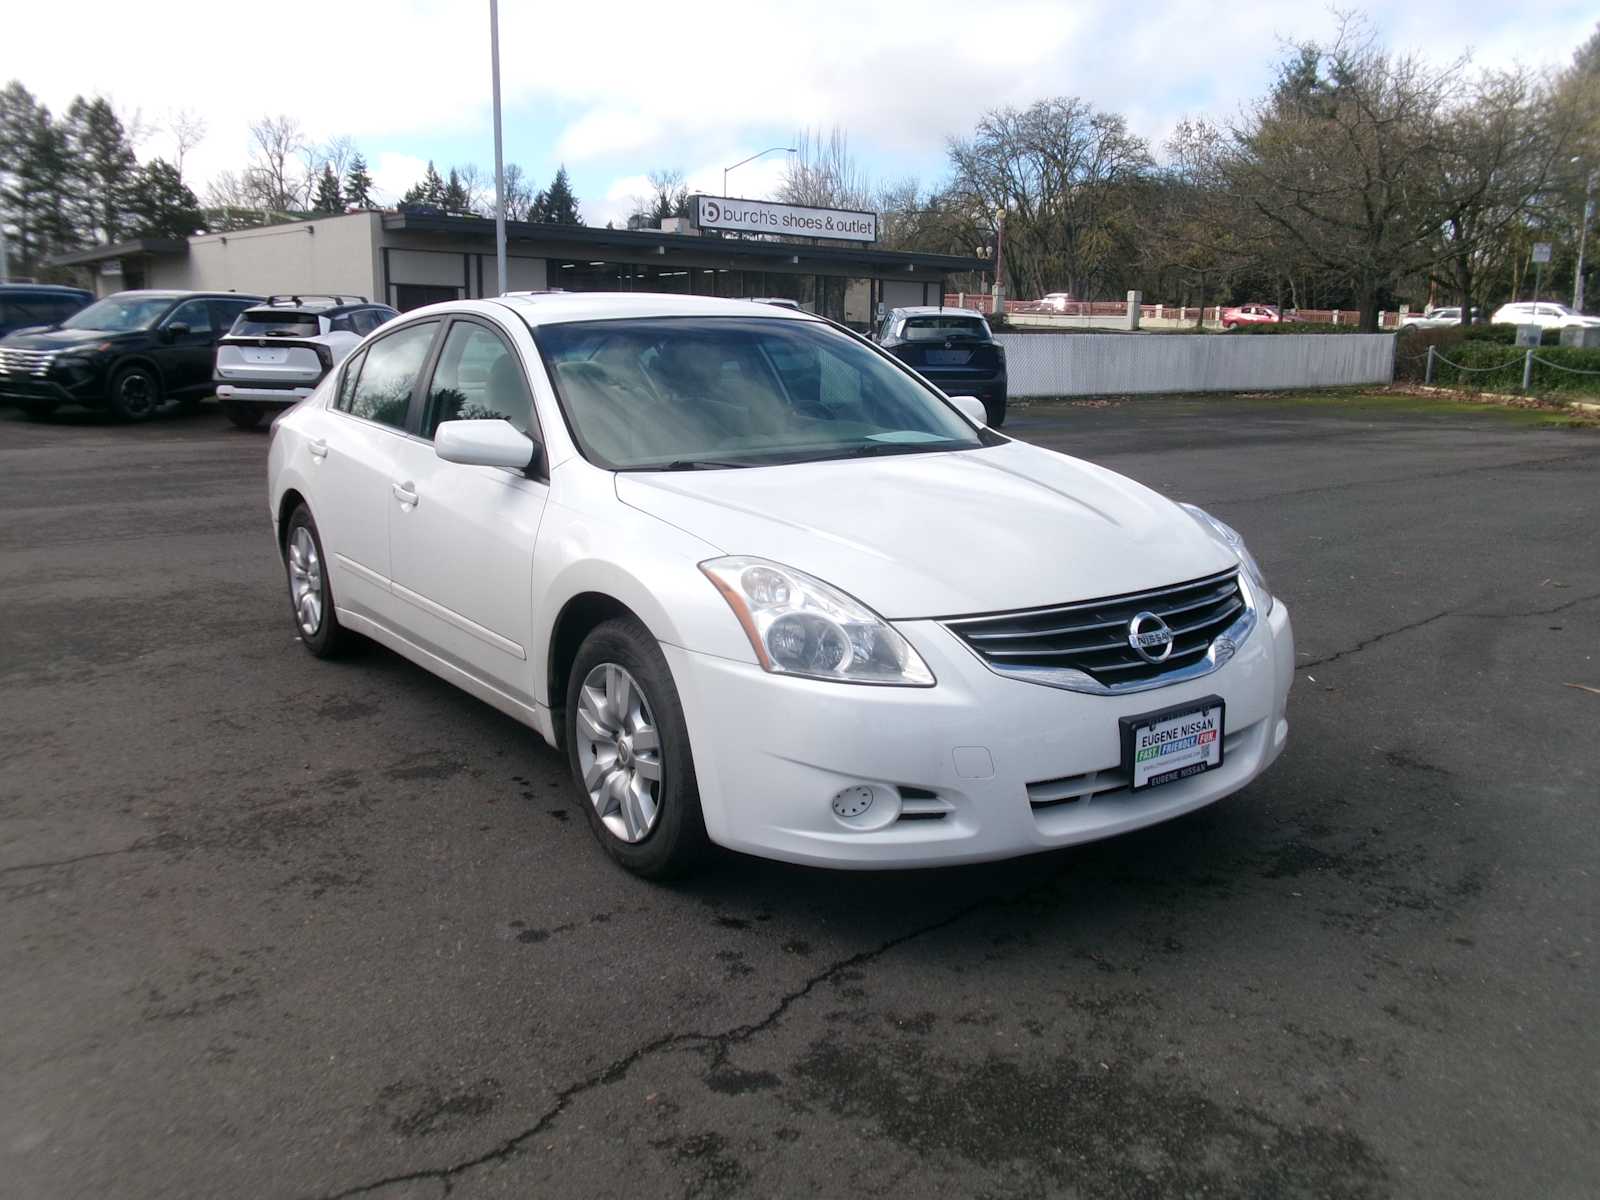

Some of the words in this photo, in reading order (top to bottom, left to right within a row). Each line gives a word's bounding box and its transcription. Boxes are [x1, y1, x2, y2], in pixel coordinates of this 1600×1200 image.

[723, 204, 778, 226] burch's
[782, 213, 823, 230] shoes
[825, 215, 835, 231] &
[836, 219, 872, 234] outlet
[1142, 727, 1179, 748] EUGENE
[1180, 718, 1215, 738] NISSAN
[1180, 762, 1207, 777] NISSAN
